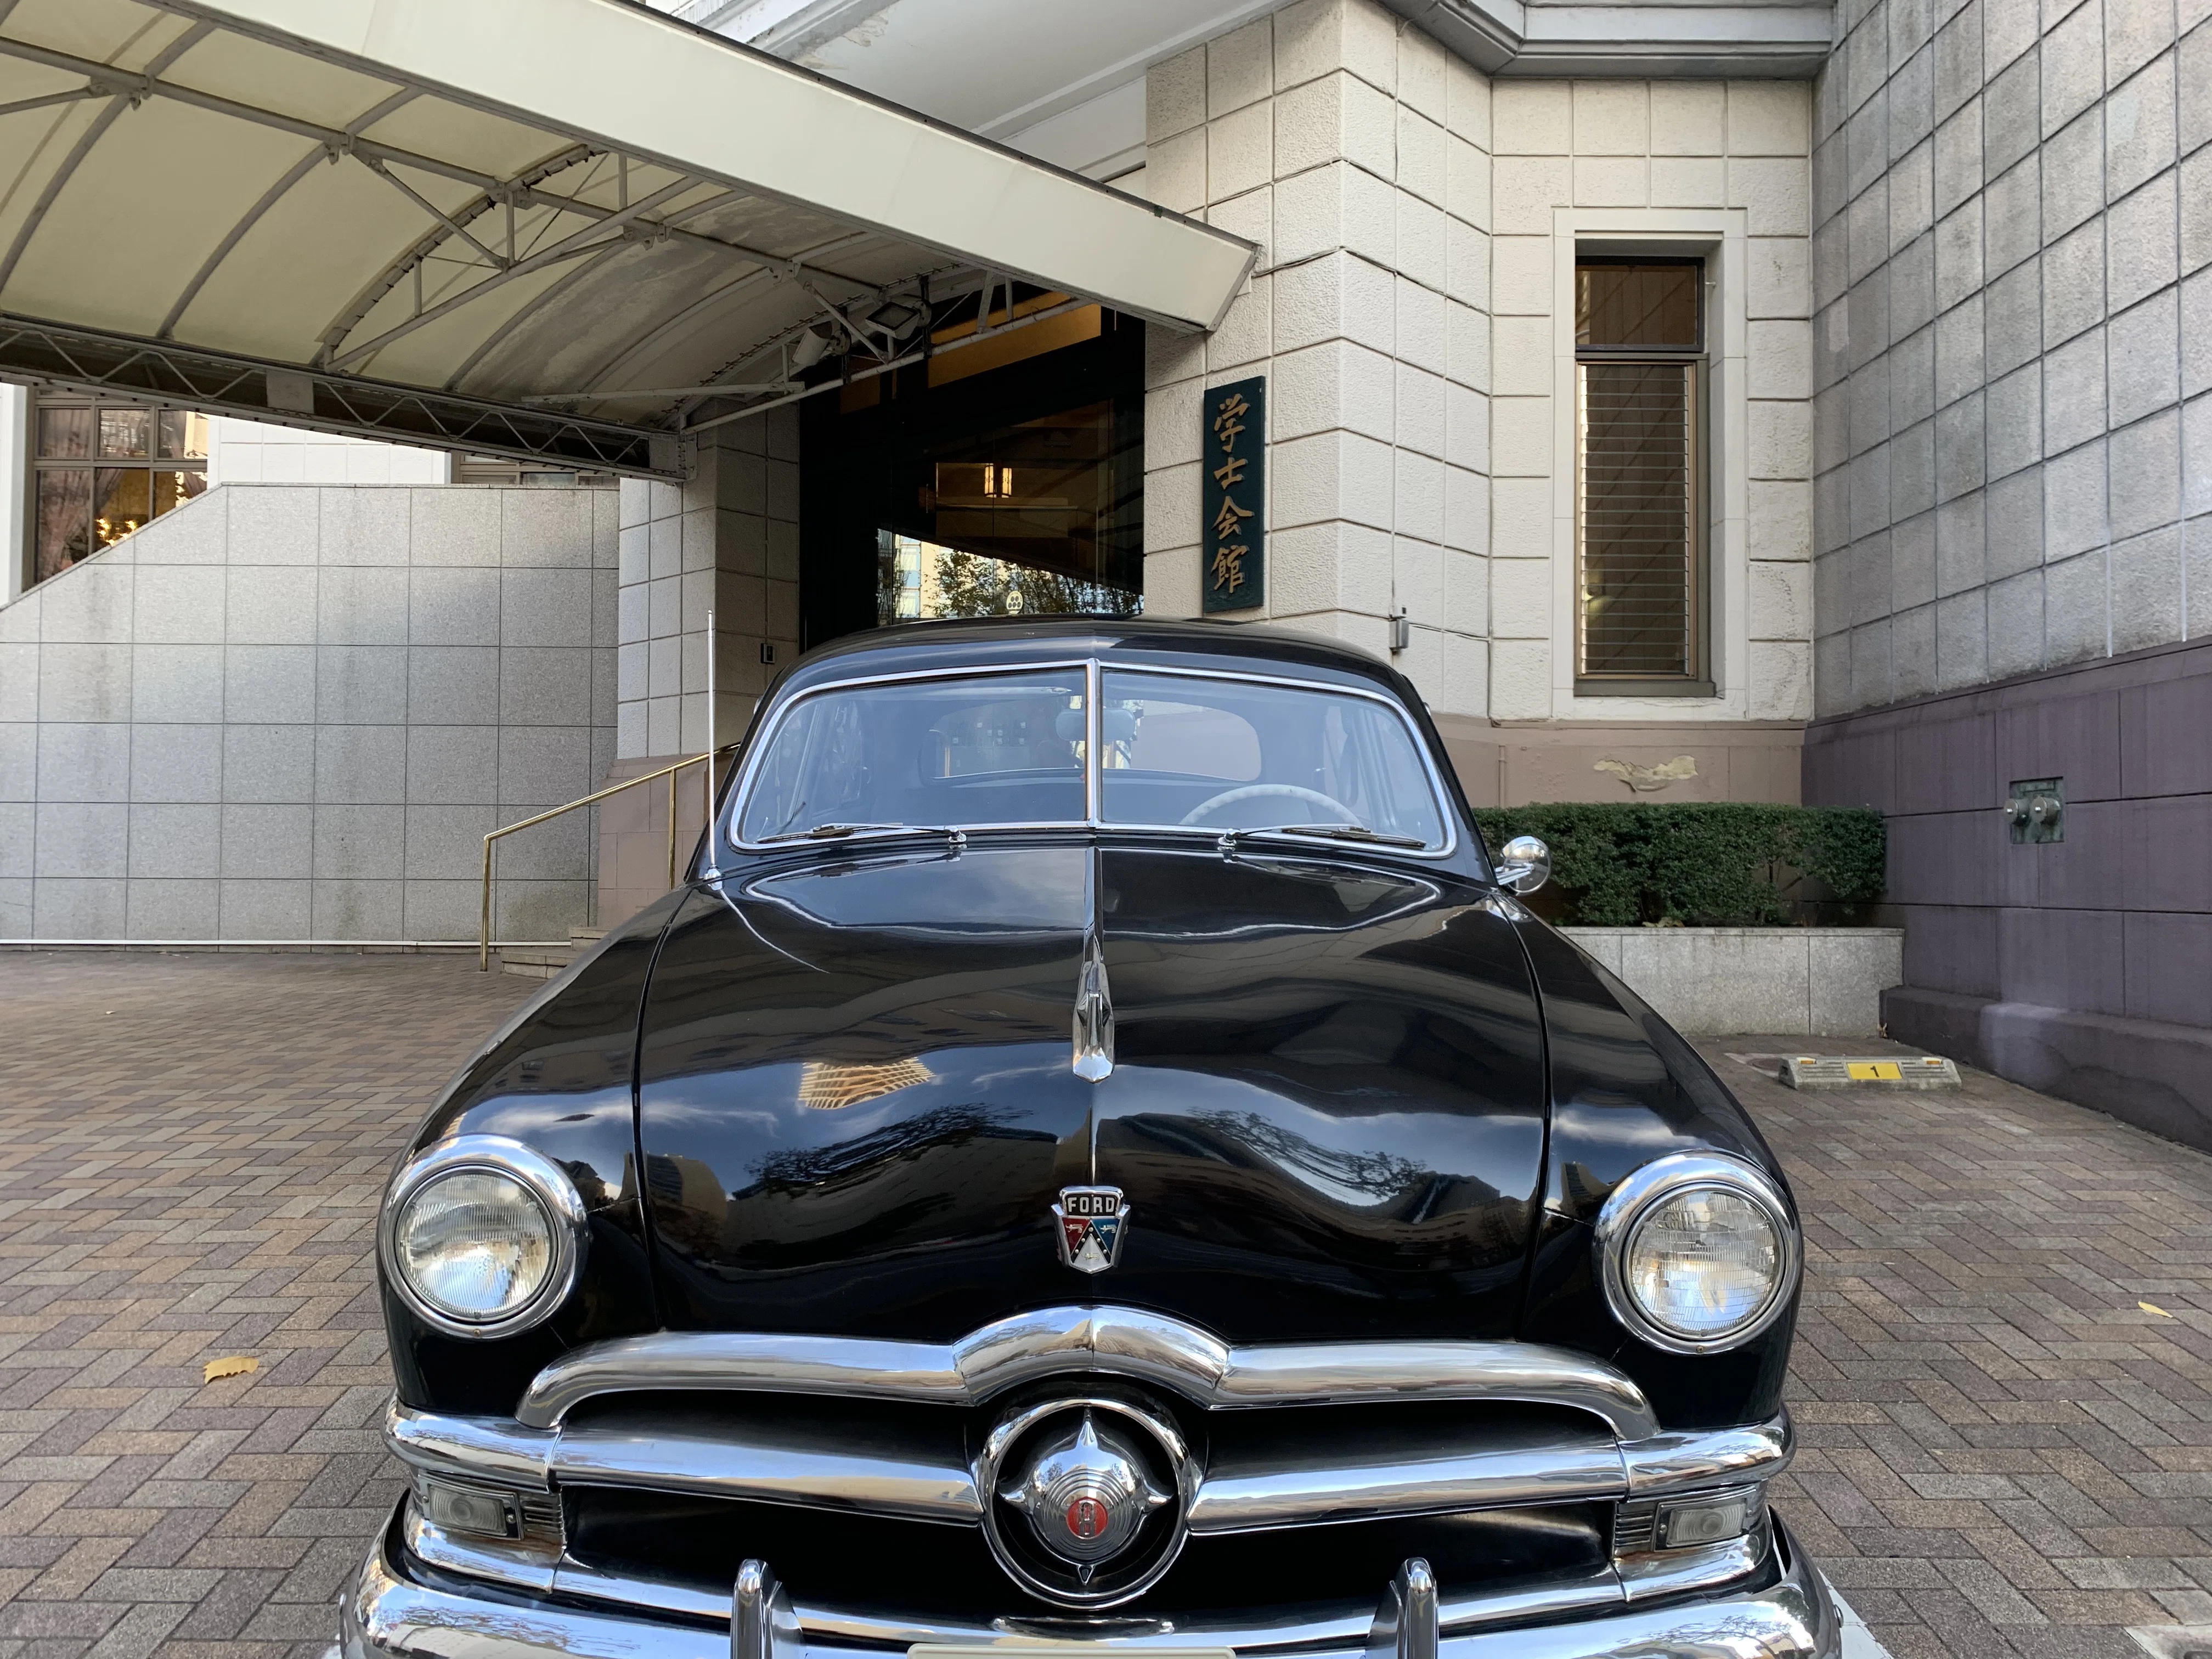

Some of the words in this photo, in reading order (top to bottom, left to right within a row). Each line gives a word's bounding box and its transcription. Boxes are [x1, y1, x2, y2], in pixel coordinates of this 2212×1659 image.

[1211, 393, 1255, 594] 学士会館
[1870, 1065, 1880, 1077] 1
[1067, 1197, 1115, 1213] FORD
[1079, 1499, 1096, 1537] 8
